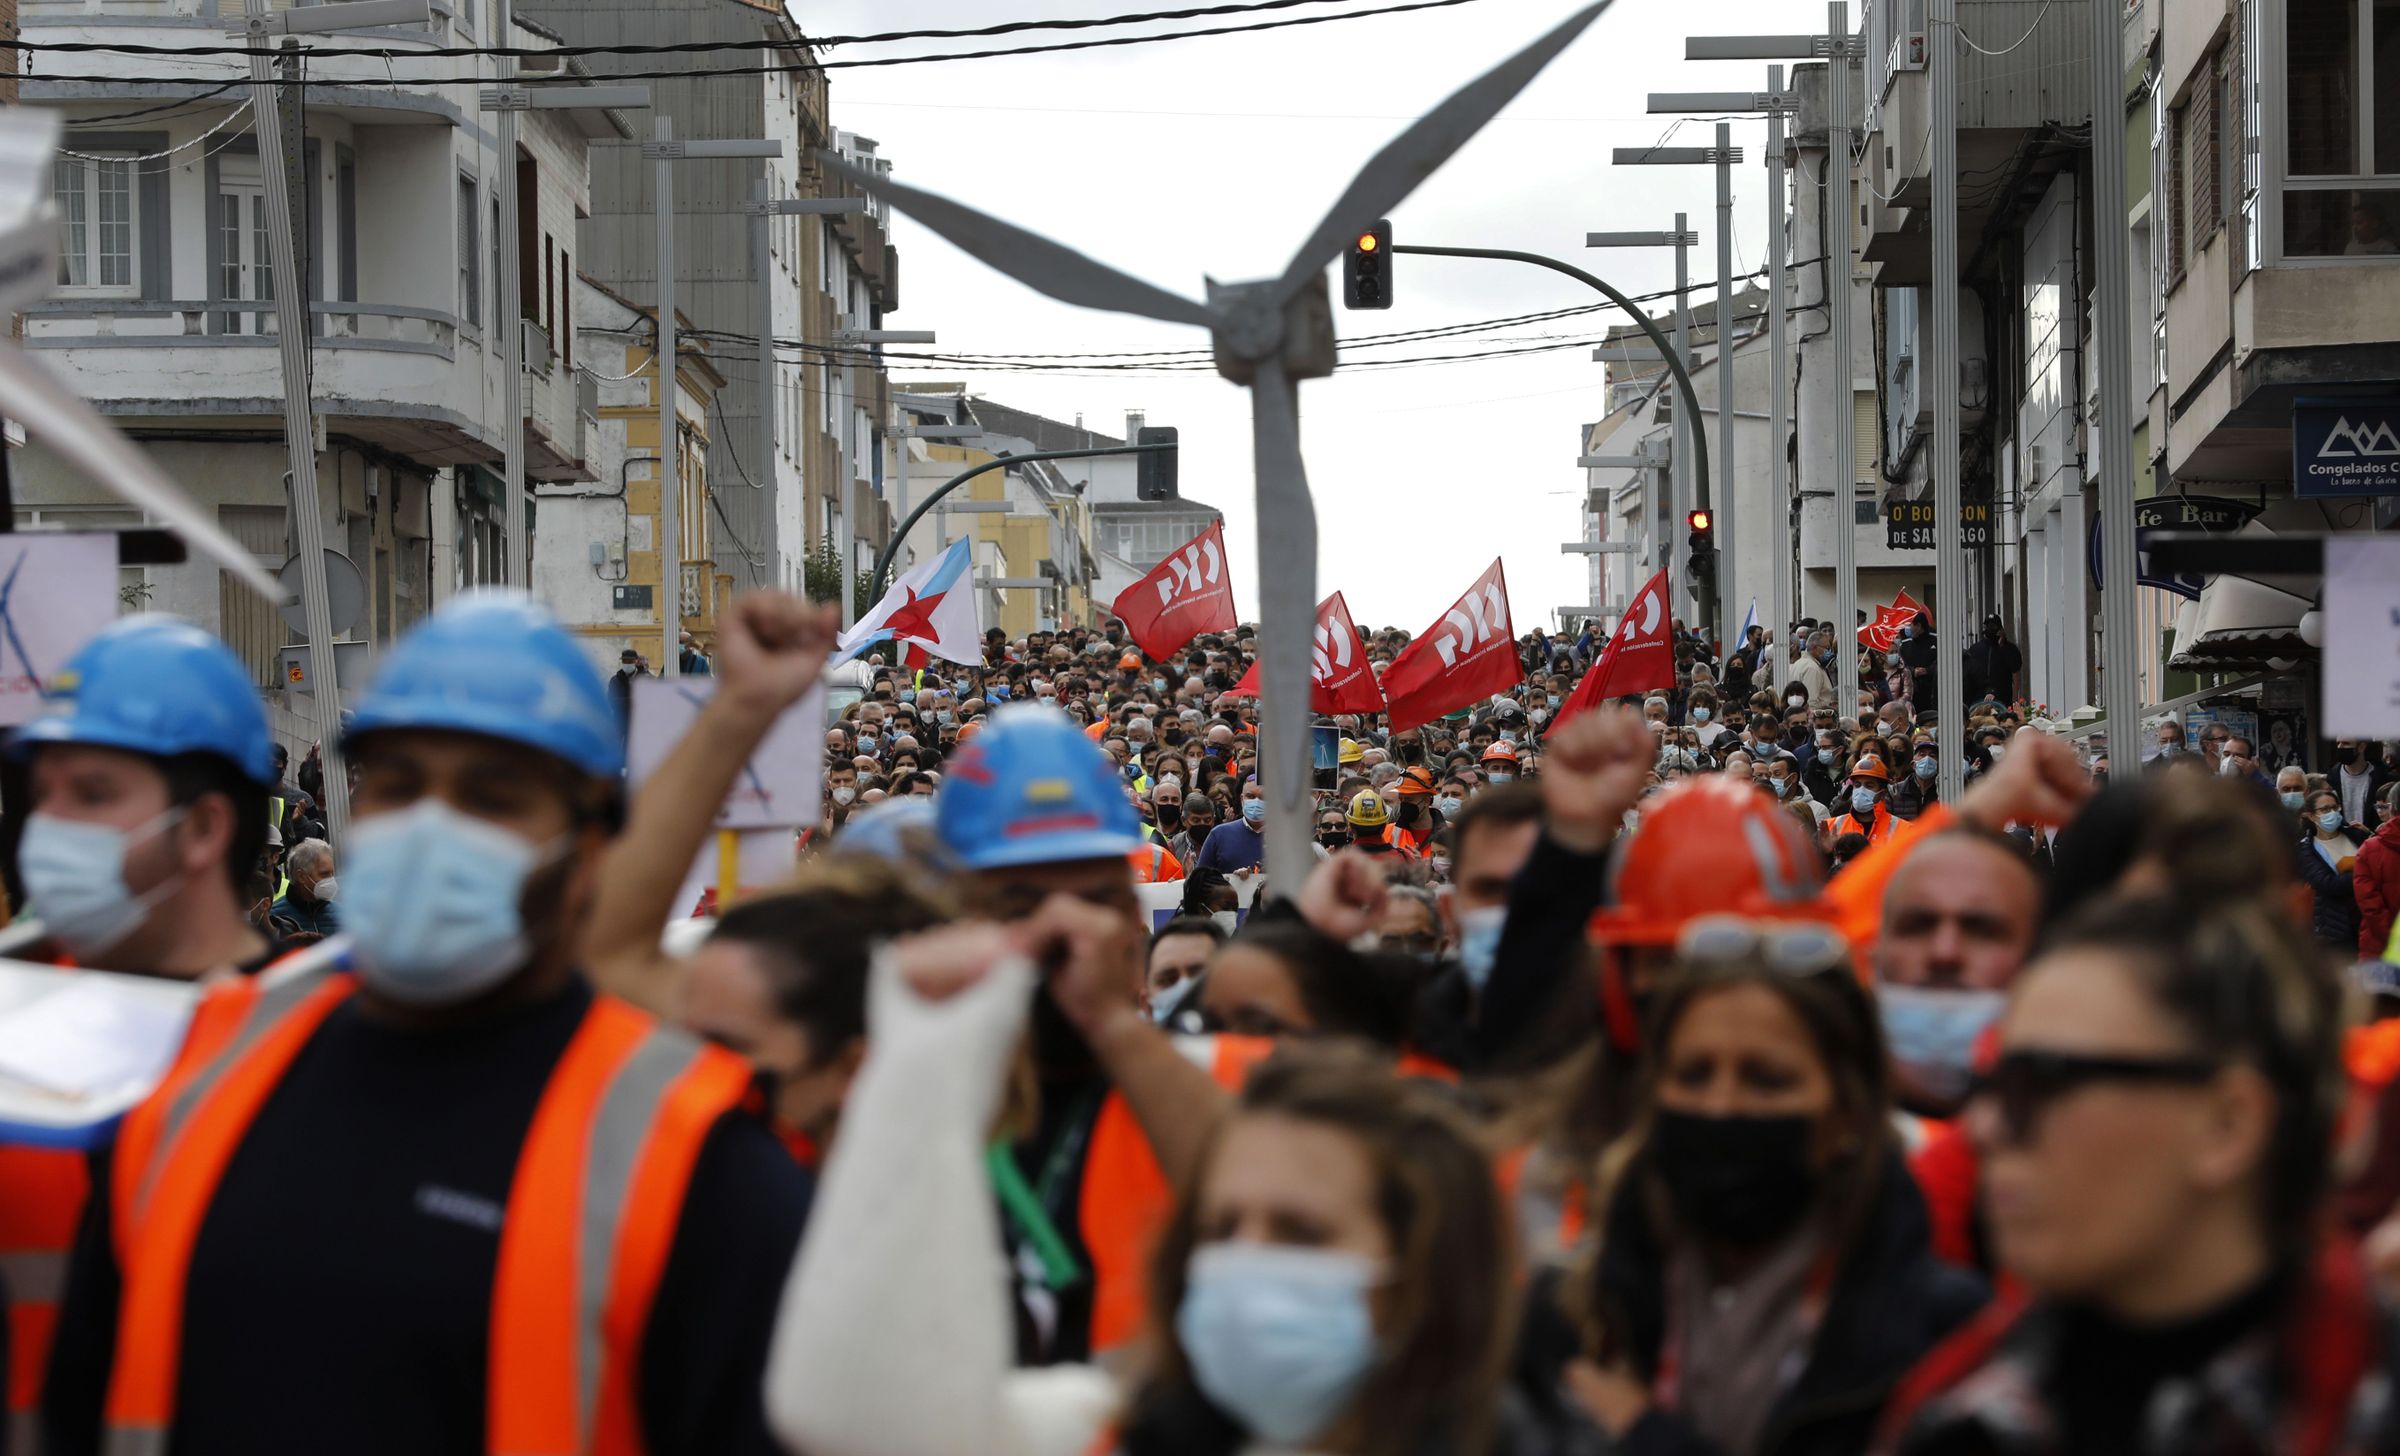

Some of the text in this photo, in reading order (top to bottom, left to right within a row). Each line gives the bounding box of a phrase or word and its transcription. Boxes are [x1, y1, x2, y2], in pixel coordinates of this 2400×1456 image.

[2308, 462, 2387, 477] Congelados
[2180, 504, 2229, 523] Bar
[1893, 530, 1908, 544] DE
